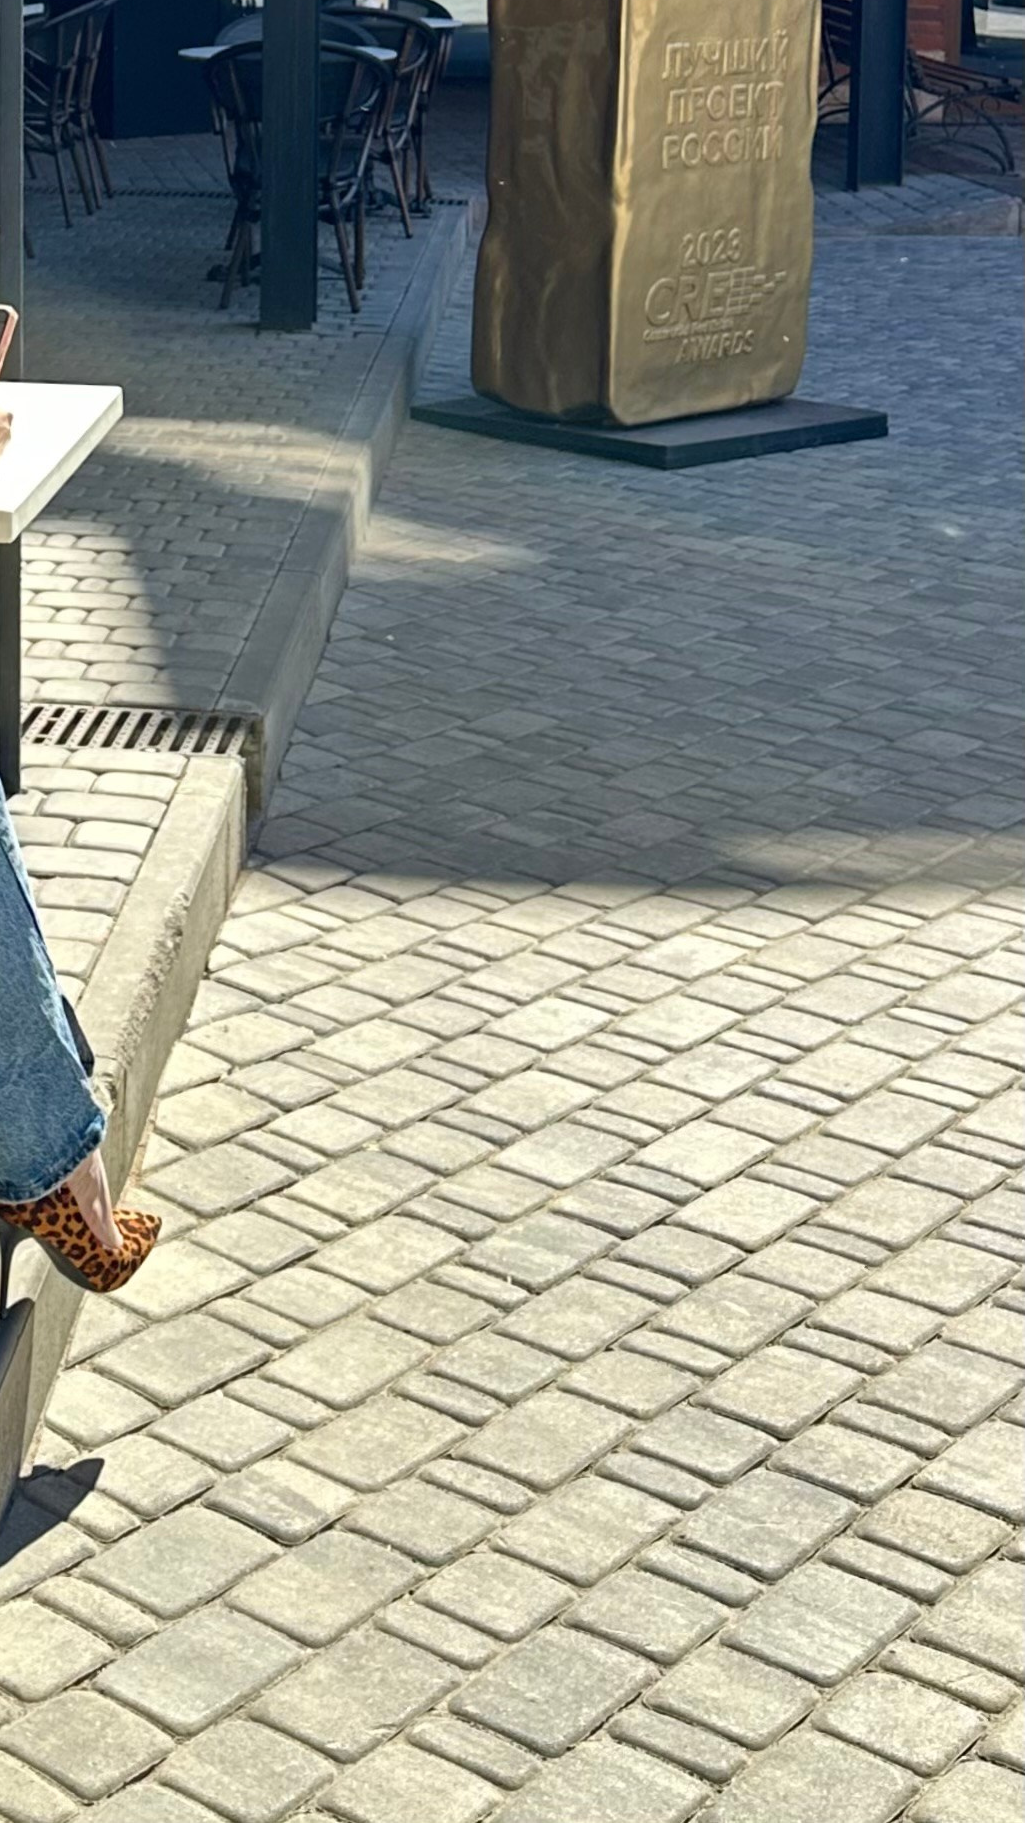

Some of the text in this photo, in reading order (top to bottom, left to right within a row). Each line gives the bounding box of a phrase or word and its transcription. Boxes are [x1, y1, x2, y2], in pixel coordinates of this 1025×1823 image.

[662, 29, 788, 79] ЛУЧШИЙ
[667, 80, 784, 125] ПРОЕКТ
[662, 125, 783, 170] РОССИИ
[680, 227, 741, 270] 2023
[674, 329, 754, 365] AWARDS
